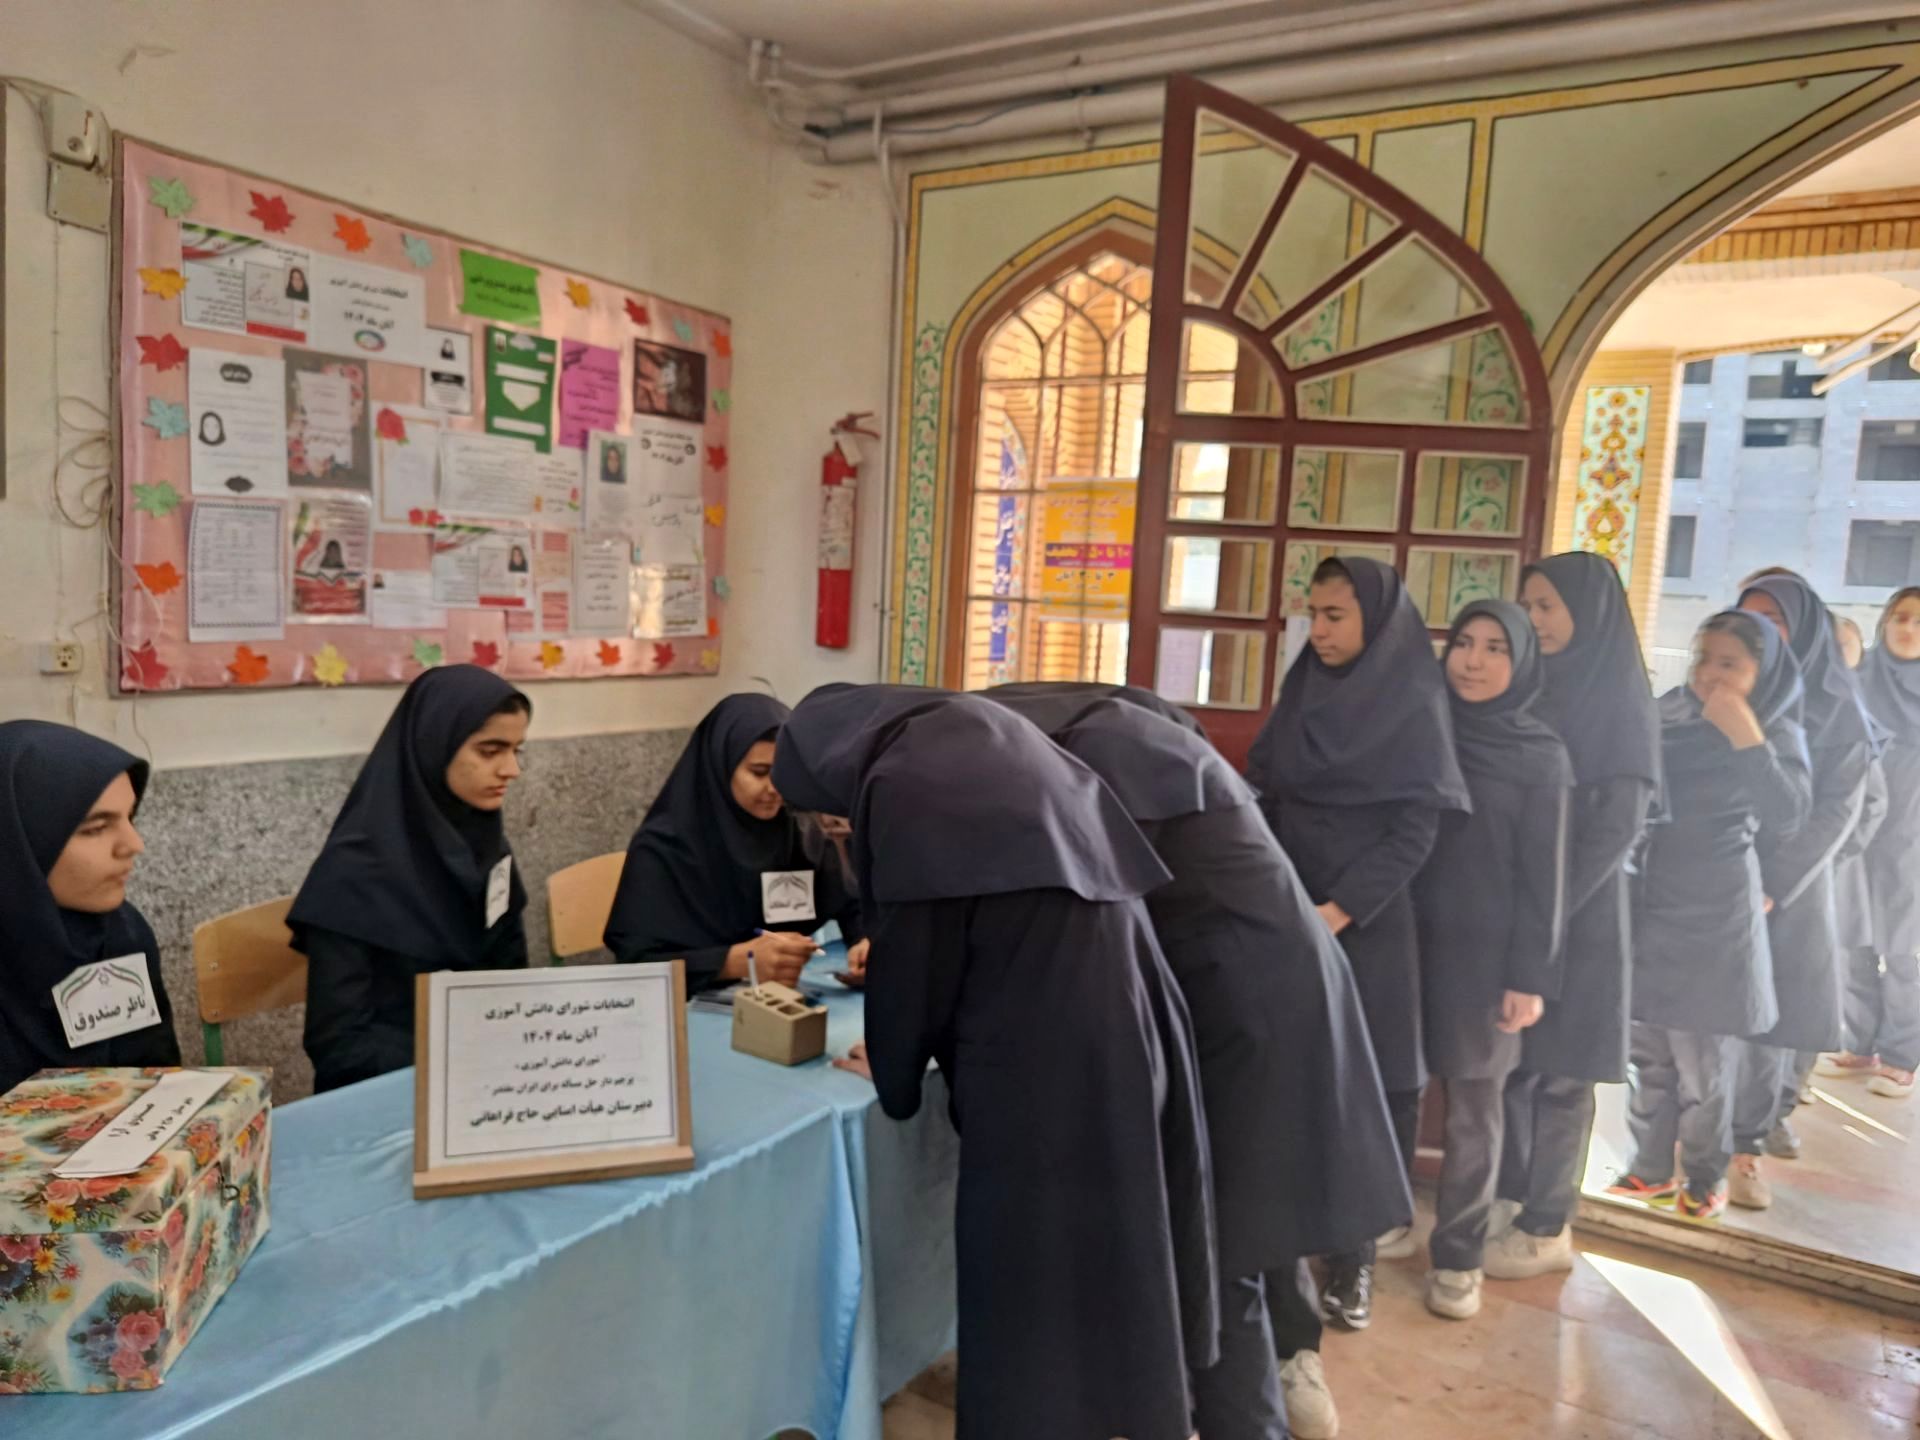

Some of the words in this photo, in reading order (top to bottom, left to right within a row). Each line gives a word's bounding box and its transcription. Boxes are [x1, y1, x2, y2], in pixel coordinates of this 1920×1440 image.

[126, 995, 146, 1020] ناظر
[525, 1003, 554, 1018] دانش
[556, 1002, 591, 1017] شورای
[593, 997, 635, 1011] انتخابات
[74, 1005, 121, 1032] صندوق
[485, 1003, 521, 1021] آموزی
[522, 1030, 553, 1045] ۱۴۰۴
[556, 1031, 573, 1043] ماه
[576, 1026, 599, 1043] آبان
[551, 1057, 573, 1070] دانش
[516, 1081, 539, 1095] ایران
[540, 1079, 559, 1093] برای
[542, 1103, 576, 1121] امنایی
[607, 1098, 653, 1114] دبیرستان
[470, 1109, 514, 1128] فراهانی
[516, 1108, 538, 1124] حاج
